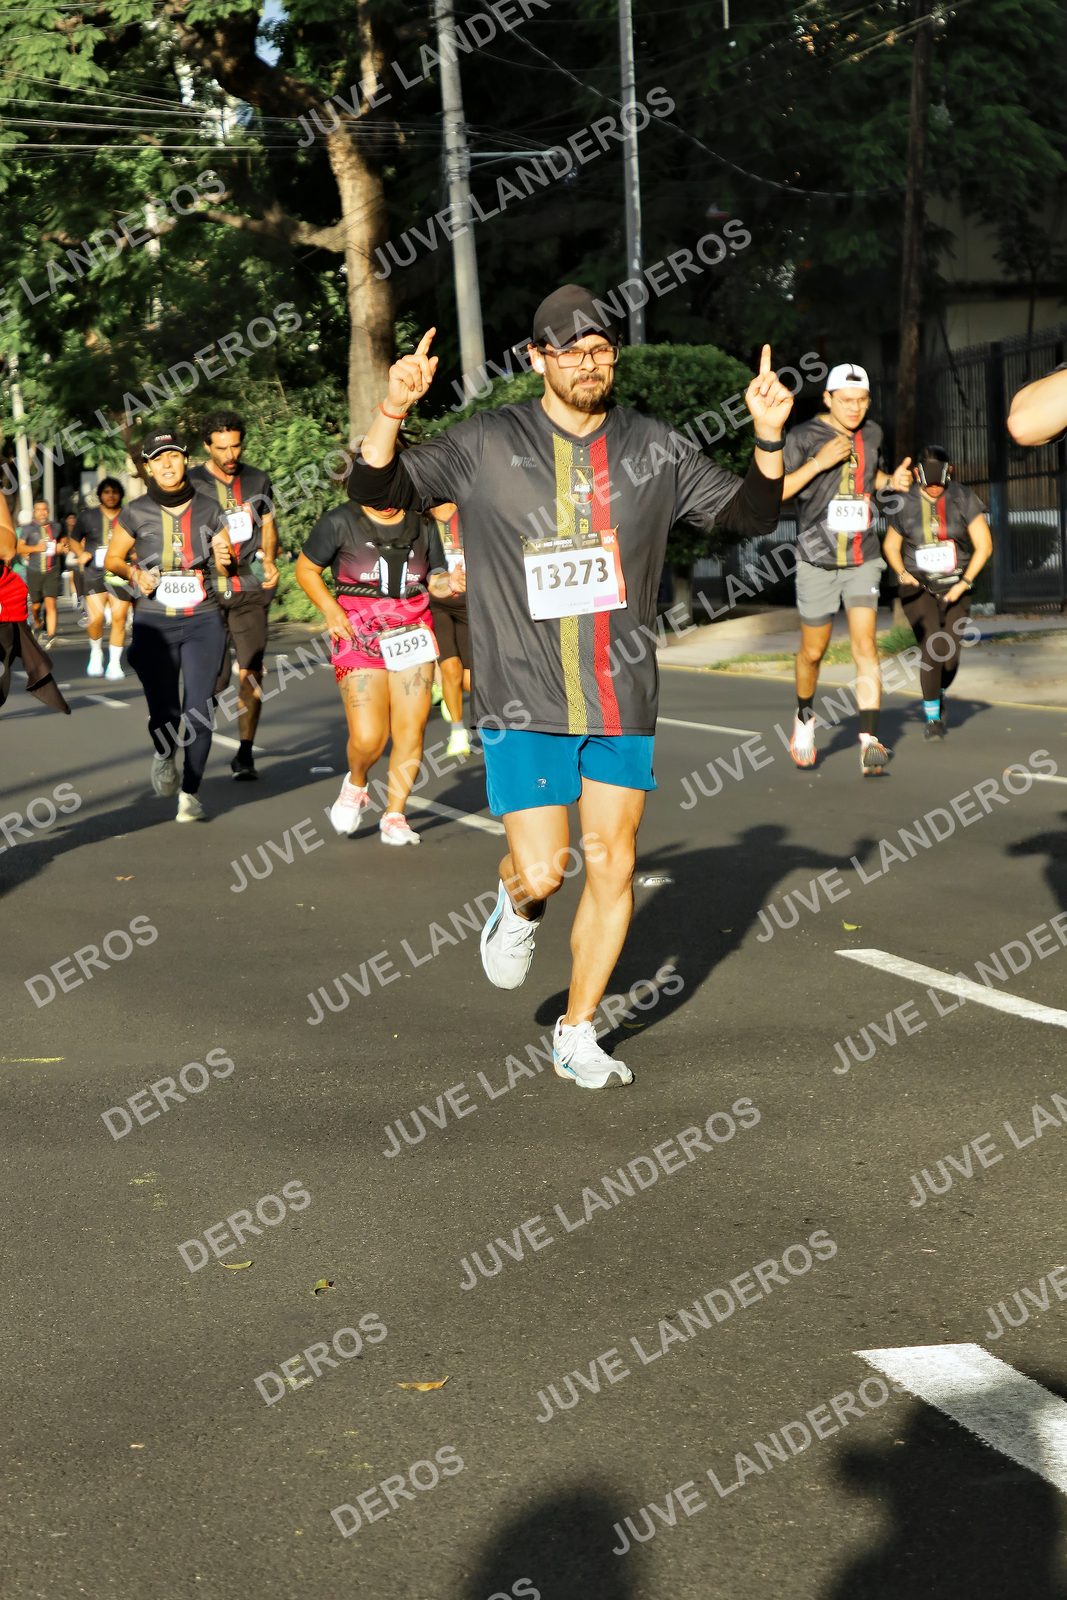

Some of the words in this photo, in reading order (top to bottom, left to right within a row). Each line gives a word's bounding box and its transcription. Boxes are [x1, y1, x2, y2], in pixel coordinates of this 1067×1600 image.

[835, 506, 864, 518] 8574
[532, 557, 609, 591] 13273
[164, 582, 196, 594] 8868
[385, 635, 429, 657] 12593
